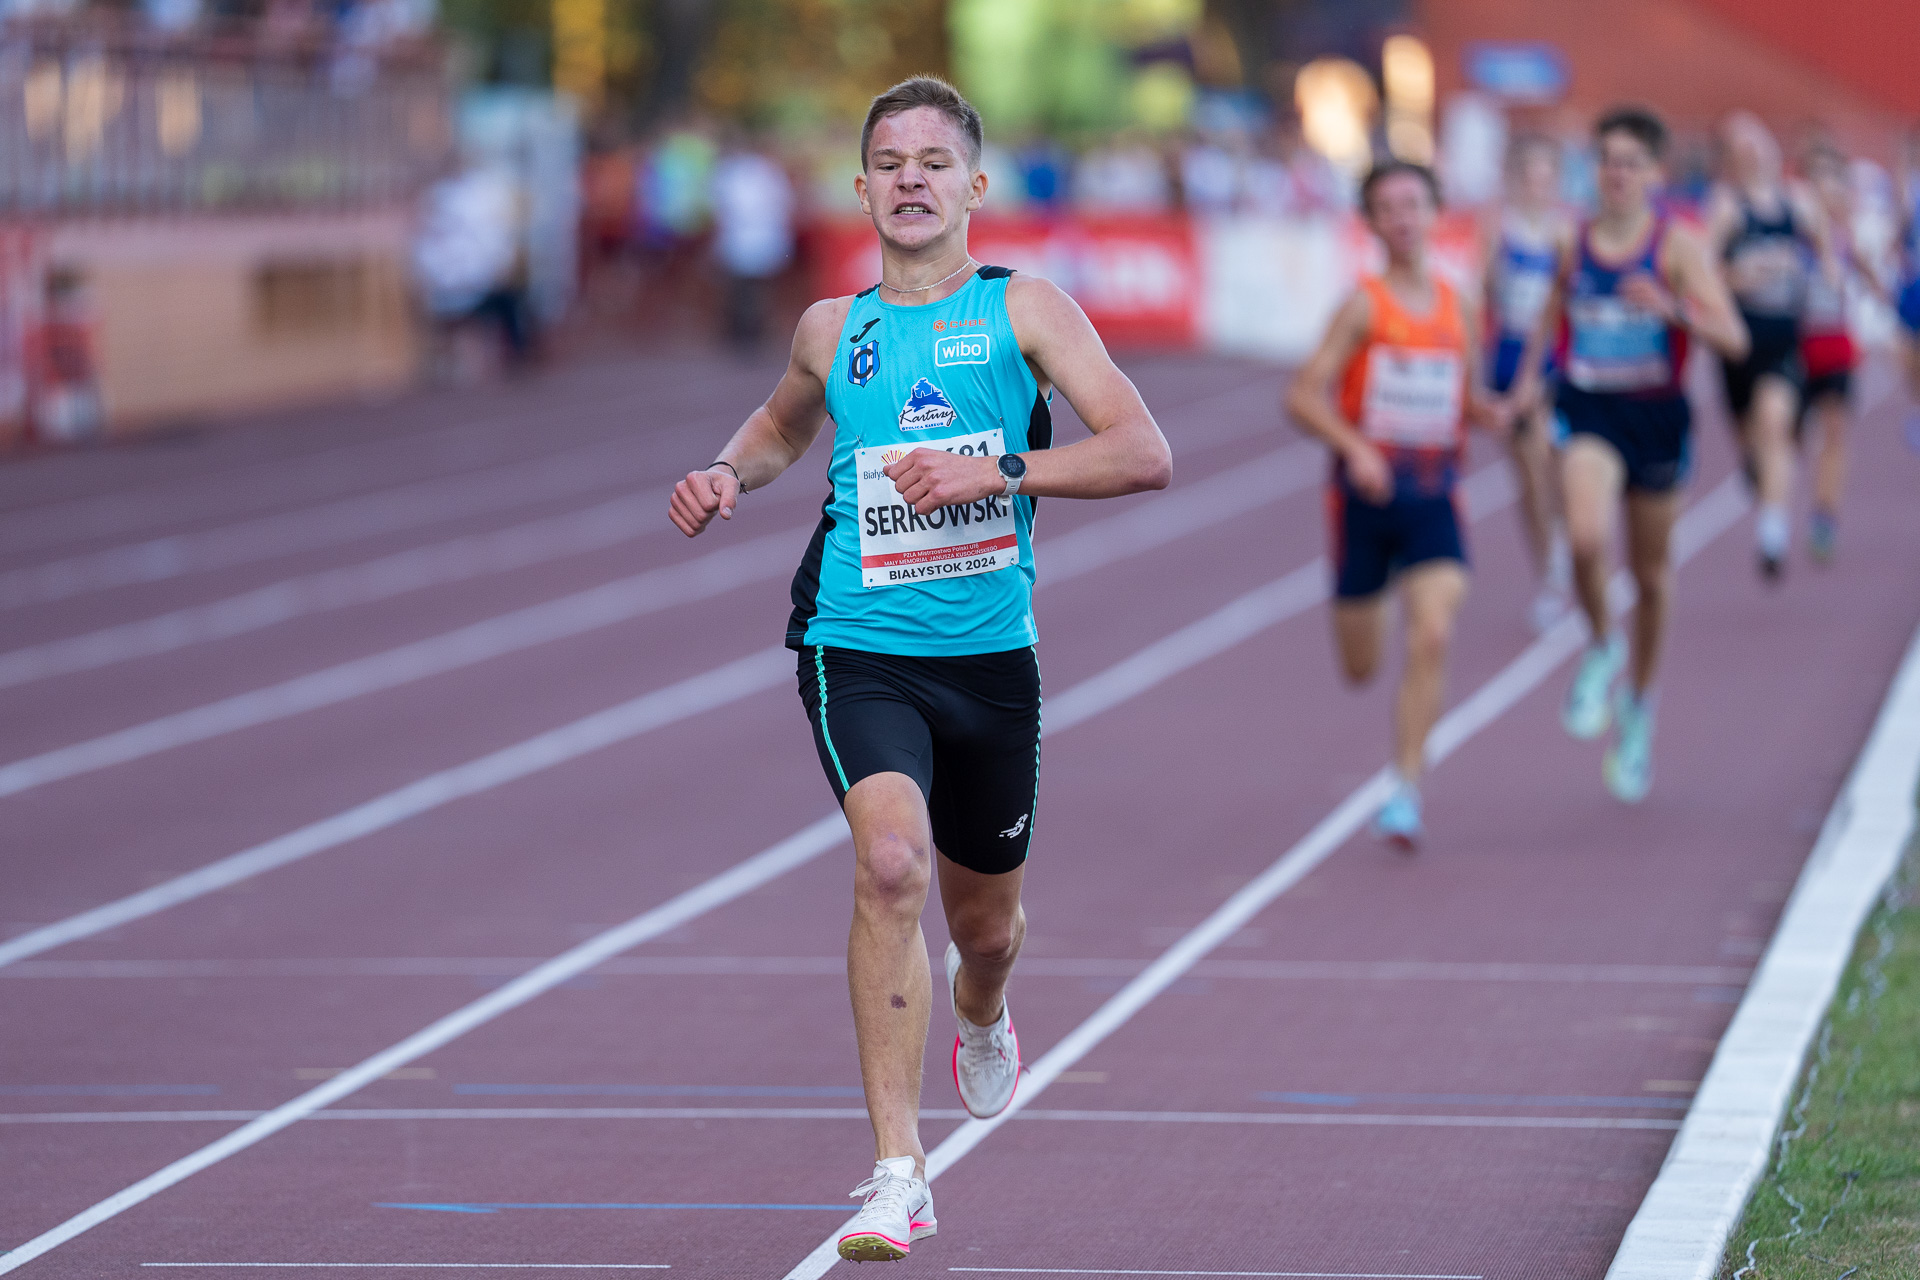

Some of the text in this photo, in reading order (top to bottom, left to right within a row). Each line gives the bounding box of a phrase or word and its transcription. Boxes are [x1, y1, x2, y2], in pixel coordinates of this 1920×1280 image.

[950, 318, 987, 329] CUBE
[942, 341, 982, 359] wibo
[899, 408, 957, 427] Kartuzy
[863, 468, 885, 481] Białys
[917, 548, 952, 557] Mistrzostwa
[952, 544, 969, 552] Polski
[929, 553, 955, 562] JANUSZA
[889, 555, 997, 581] BIAŁYSTOK 2024
